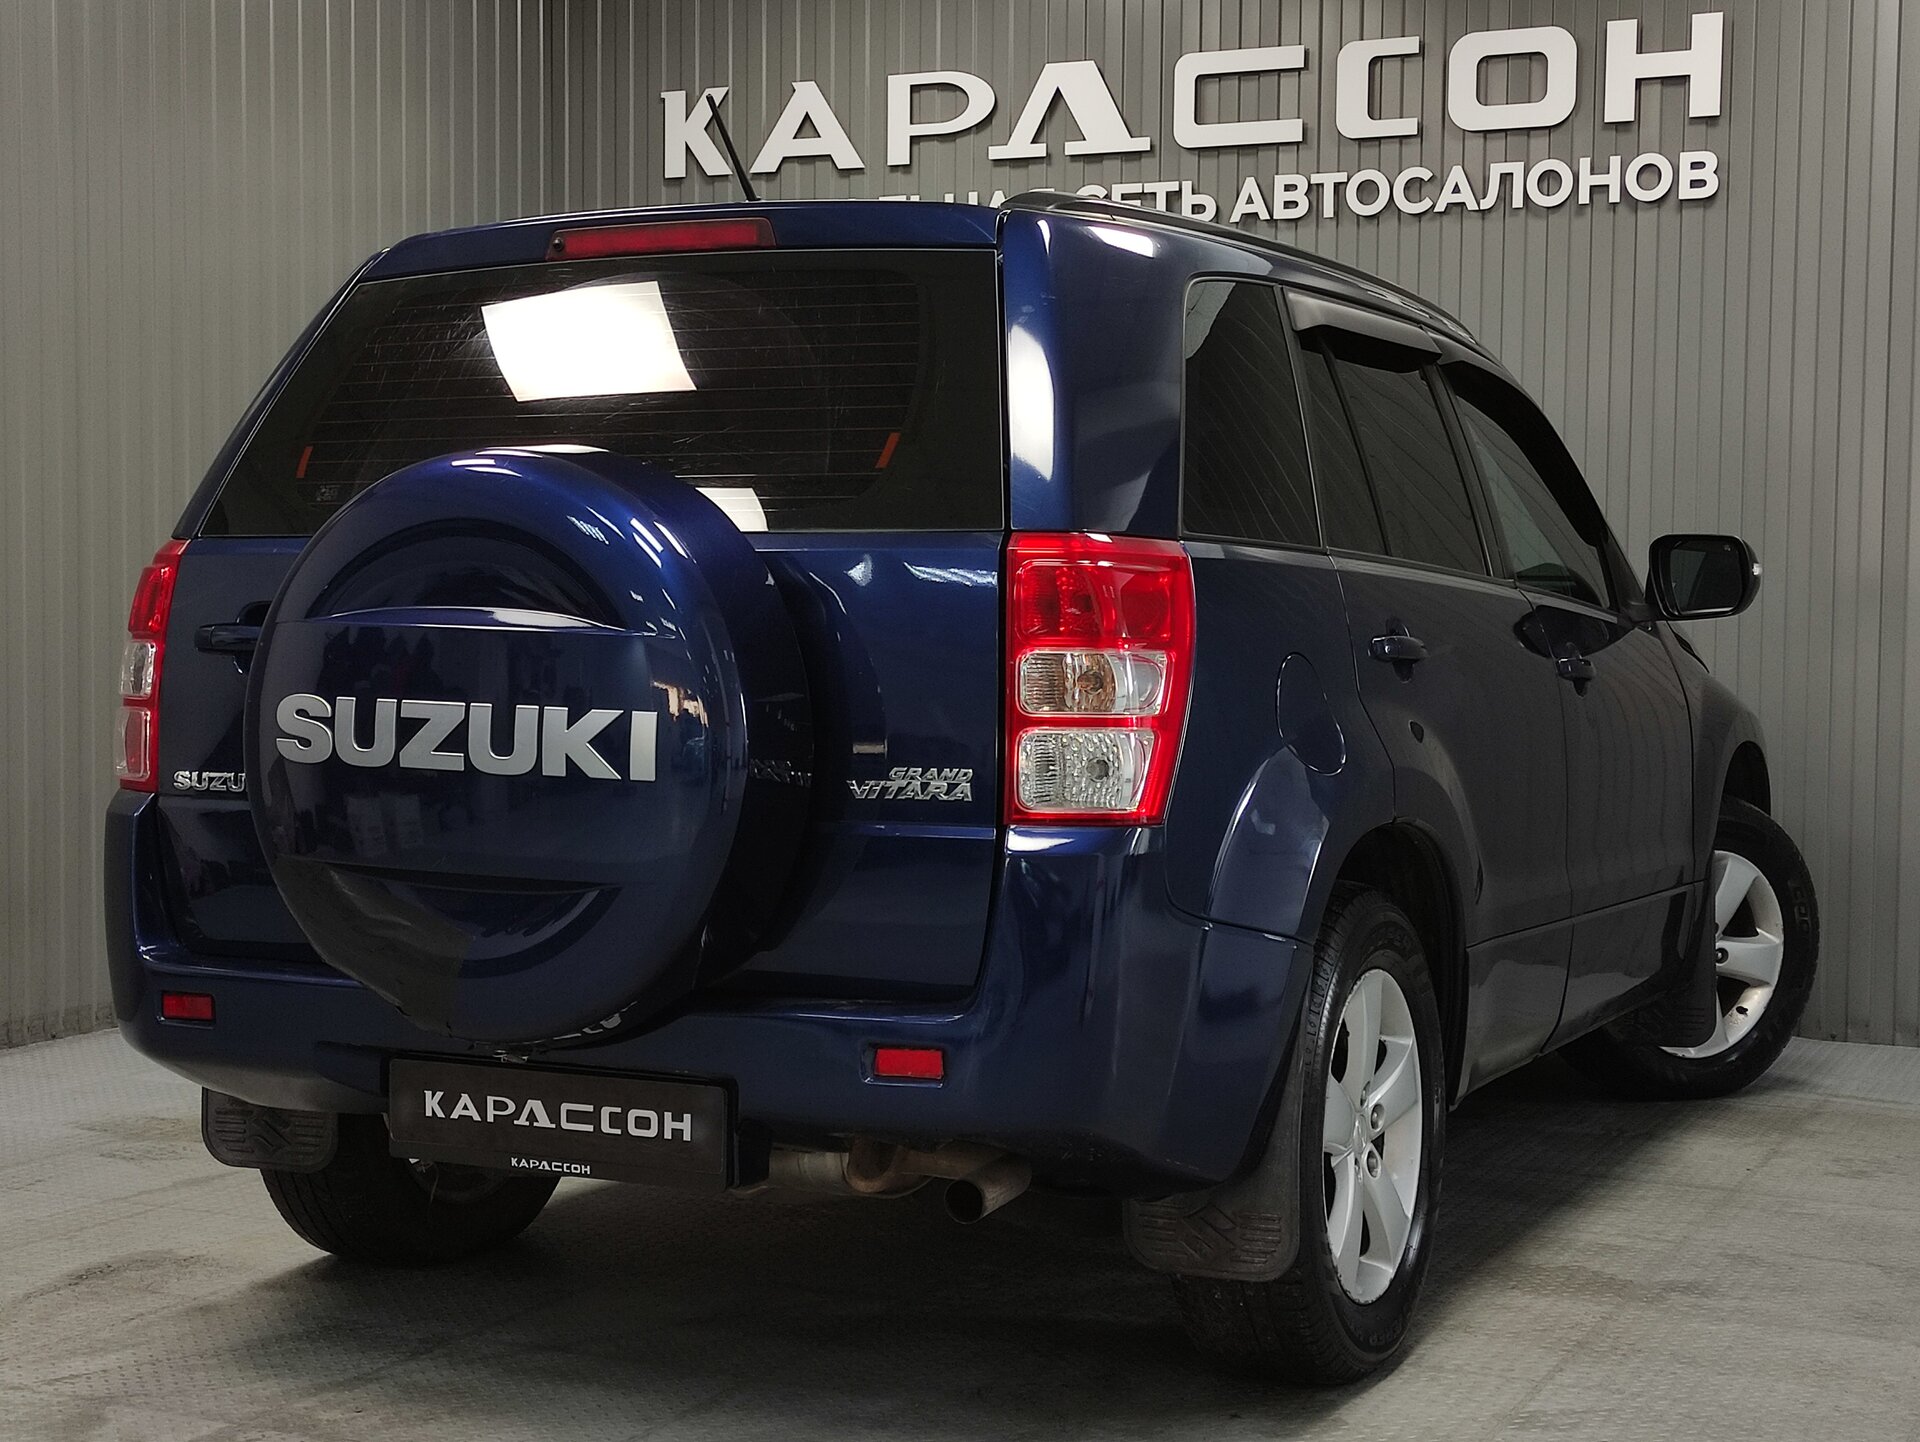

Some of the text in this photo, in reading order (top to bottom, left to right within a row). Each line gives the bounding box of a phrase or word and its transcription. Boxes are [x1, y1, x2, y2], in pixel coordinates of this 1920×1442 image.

[1229, 150, 1720, 224] АВТОСАЛОНОВ
[276, 693, 659, 782] SUZUKI
[173, 770, 246, 792] SUZU
[888, 766, 973, 782] GRAND
[847, 780, 973, 802] VITARA
